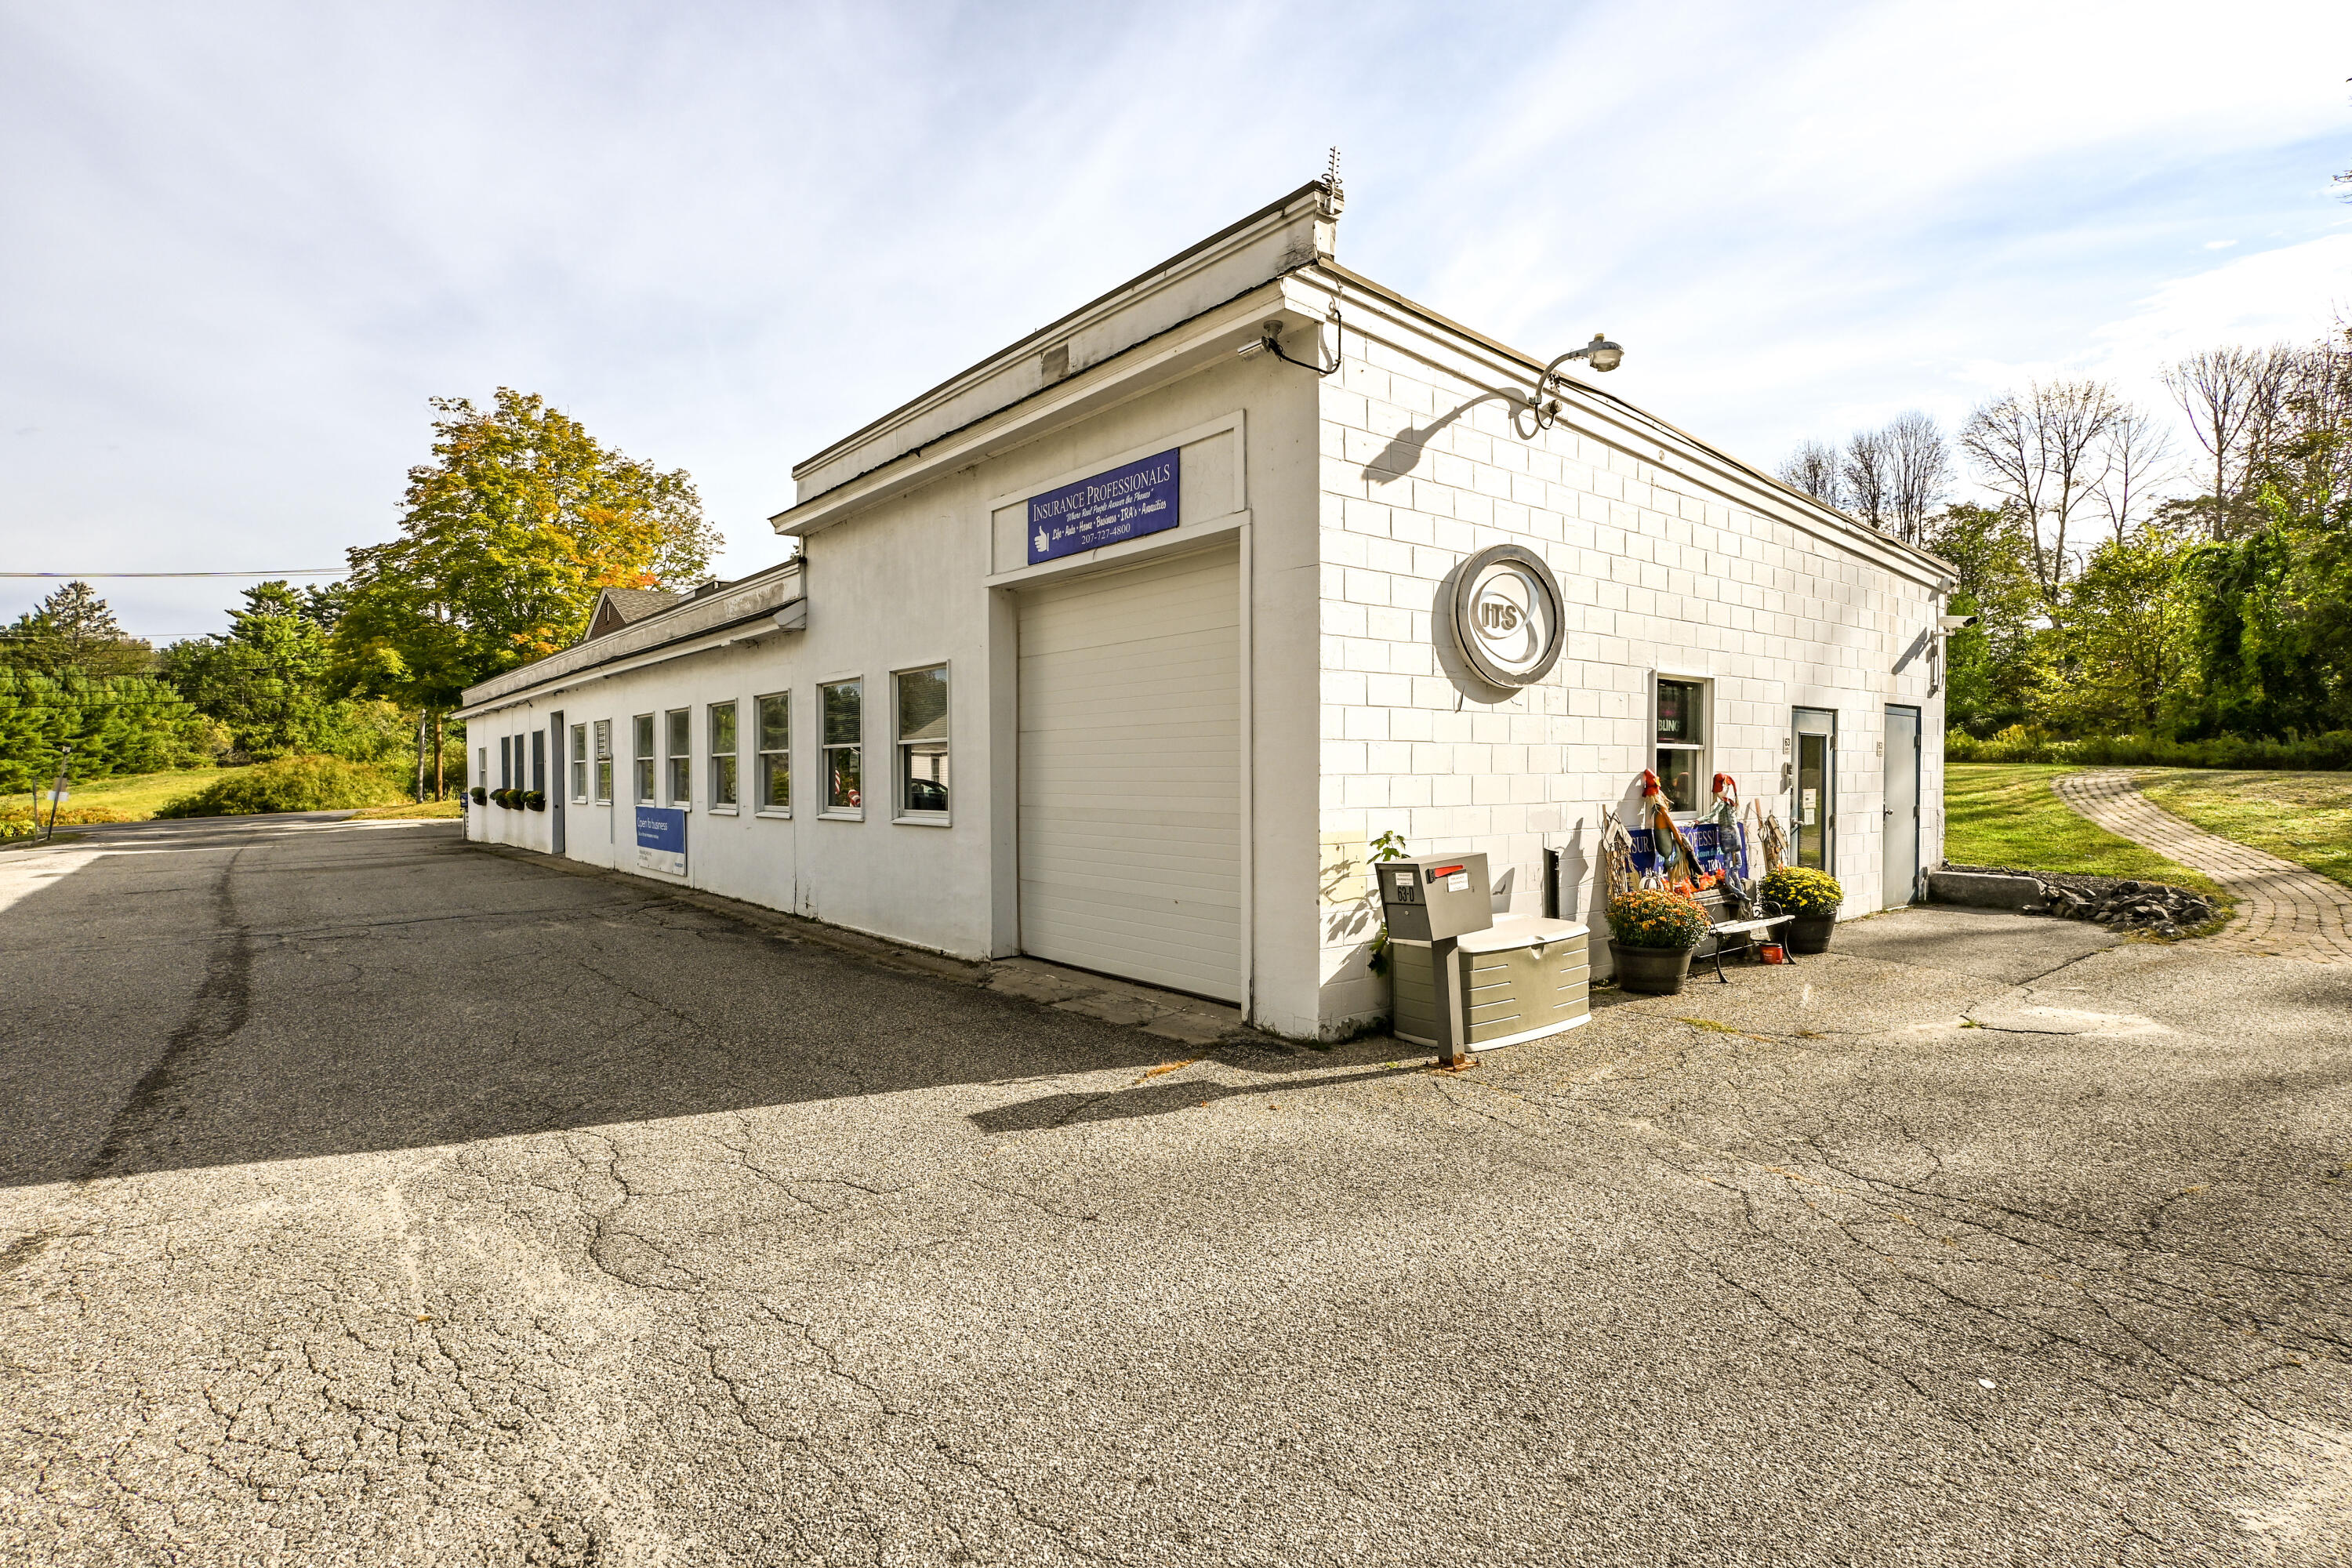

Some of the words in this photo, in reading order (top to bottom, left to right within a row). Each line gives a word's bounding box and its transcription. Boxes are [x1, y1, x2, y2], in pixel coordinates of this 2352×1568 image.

[1033, 491, 1085, 522] INSURANCE
[1087, 463, 1171, 505] PROFESSIONALS
[1052, 526, 1062, 540] Life
[1065, 524, 1076, 537] Auto
[1079, 520, 1093, 532] Home
[1096, 513, 1117, 528] Business
[1120, 506, 1138, 521] IRA's
[1142, 499, 1167, 515] Annuities
[1082, 506, 1093, 518] Real
[1093, 501, 1107, 515] People
[1108, 499, 1124, 510] Answer
[1081, 523, 1131, 546] 207-727-4800
[1481, 602, 1518, 630] ITS
[637, 818, 647, 829] Open
[652, 819, 668, 830] business
[1397, 886, 1415, 902] 63-D
